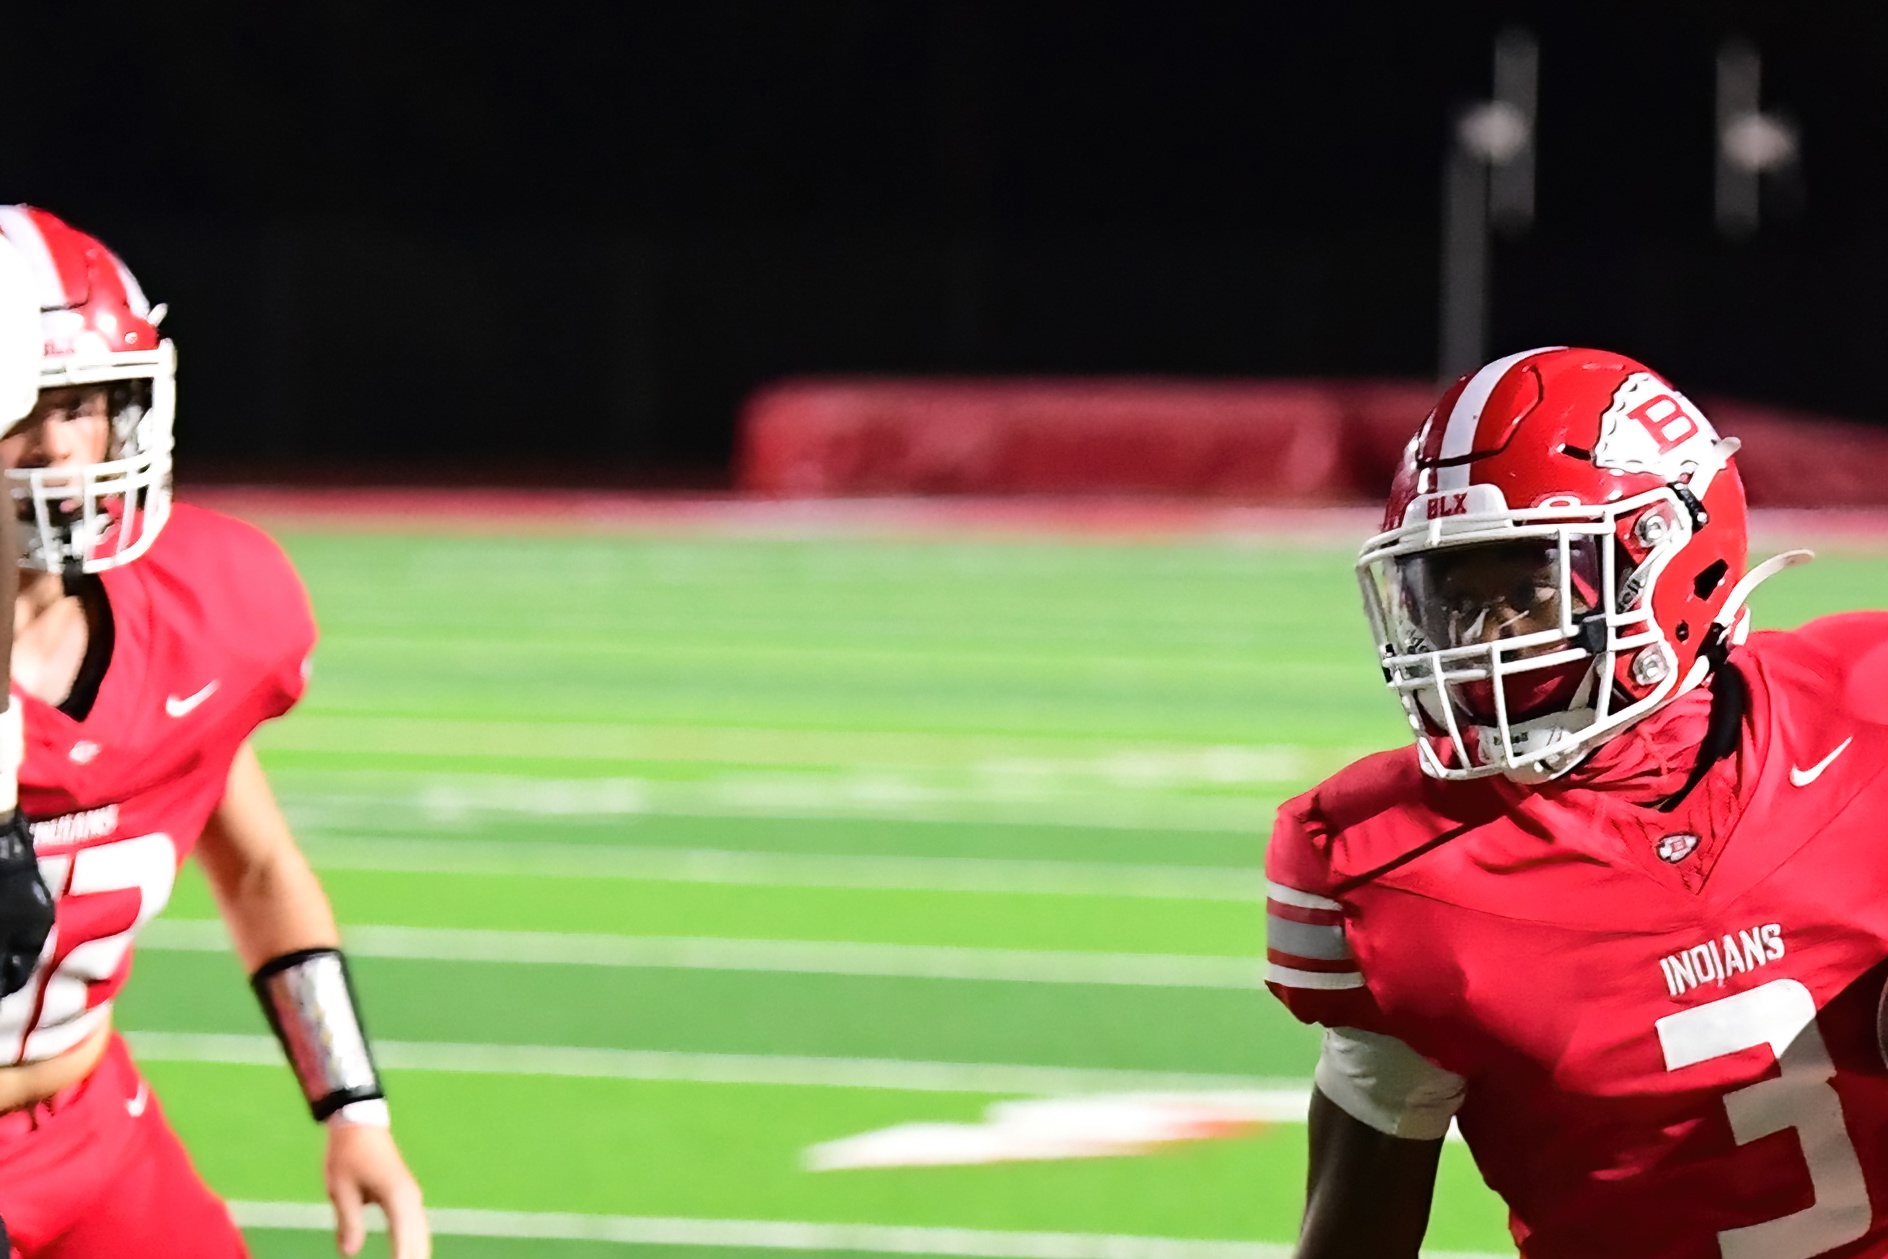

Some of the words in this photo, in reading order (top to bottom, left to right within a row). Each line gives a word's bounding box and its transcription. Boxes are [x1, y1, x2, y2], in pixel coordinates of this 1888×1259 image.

[1626, 394, 1698, 455] B
[1427, 493, 1467, 520] BLX
[1660, 923, 1785, 997] INDIANS
